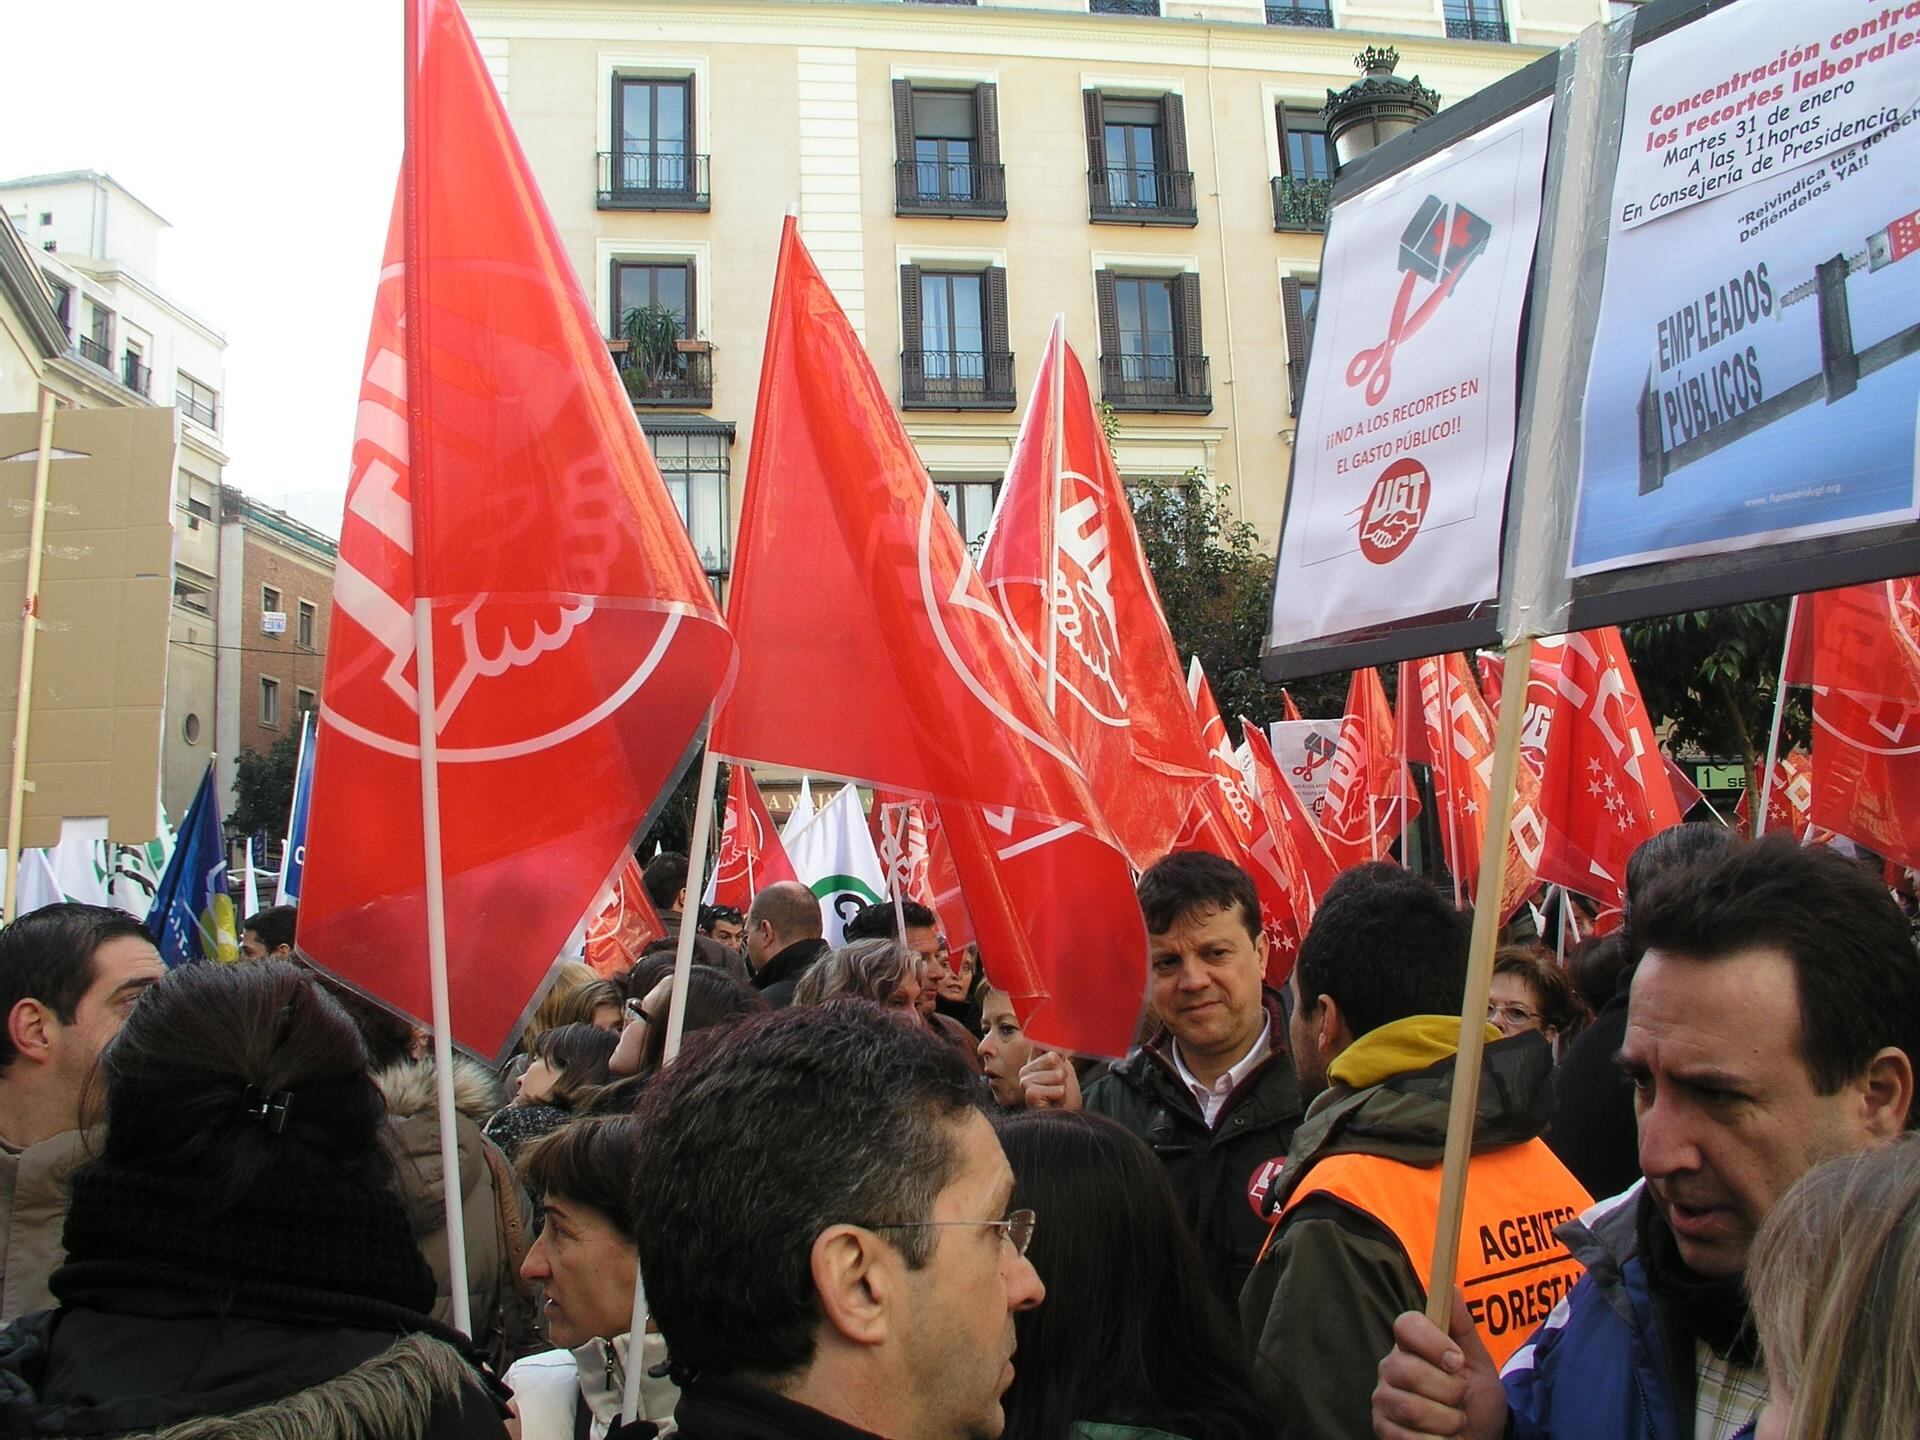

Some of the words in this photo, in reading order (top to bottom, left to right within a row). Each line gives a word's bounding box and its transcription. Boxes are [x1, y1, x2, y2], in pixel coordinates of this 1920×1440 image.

[1649, 44, 1820, 126] Concentración
[1829, 0, 1920, 50] contra
[1646, 127, 1679, 153] los
[1685, 83, 1784, 137] recortes
[1663, 131, 1727, 169] Martes
[1735, 115, 1756, 138] 31
[1767, 105, 1790, 126] de
[1799, 80, 1855, 113] enero
[1622, 203, 1643, 223] En
[1649, 164, 1743, 212] Consejería
[1751, 154, 1773, 175] de
[1782, 106, 1898, 164] Presidencia
[1687, 158, 1701, 178] A
[1710, 149, 1735, 170] las
[1830, 148, 1857, 171] tus
[1739, 180, 1832, 244] Defiéndelos
[1835, 153, 1870, 183] YA!!
[1657, 261, 1773, 374] EMPLEADOS
[1355, 422, 1364, 438] A
[1367, 411, 1389, 433] LOS
[1392, 386, 1457, 424] RECORTES
[1460, 378, 1479, 399] EN
[1663, 345, 1763, 449] PÚBLICOS
[1337, 458, 1349, 474] EL
[1352, 442, 1393, 468] GASTO
[1395, 415, 1461, 455] PÚBLICO!!
[1368, 470, 1426, 523] UGT
[1464, 1271, 1580, 1336] FORESTA
